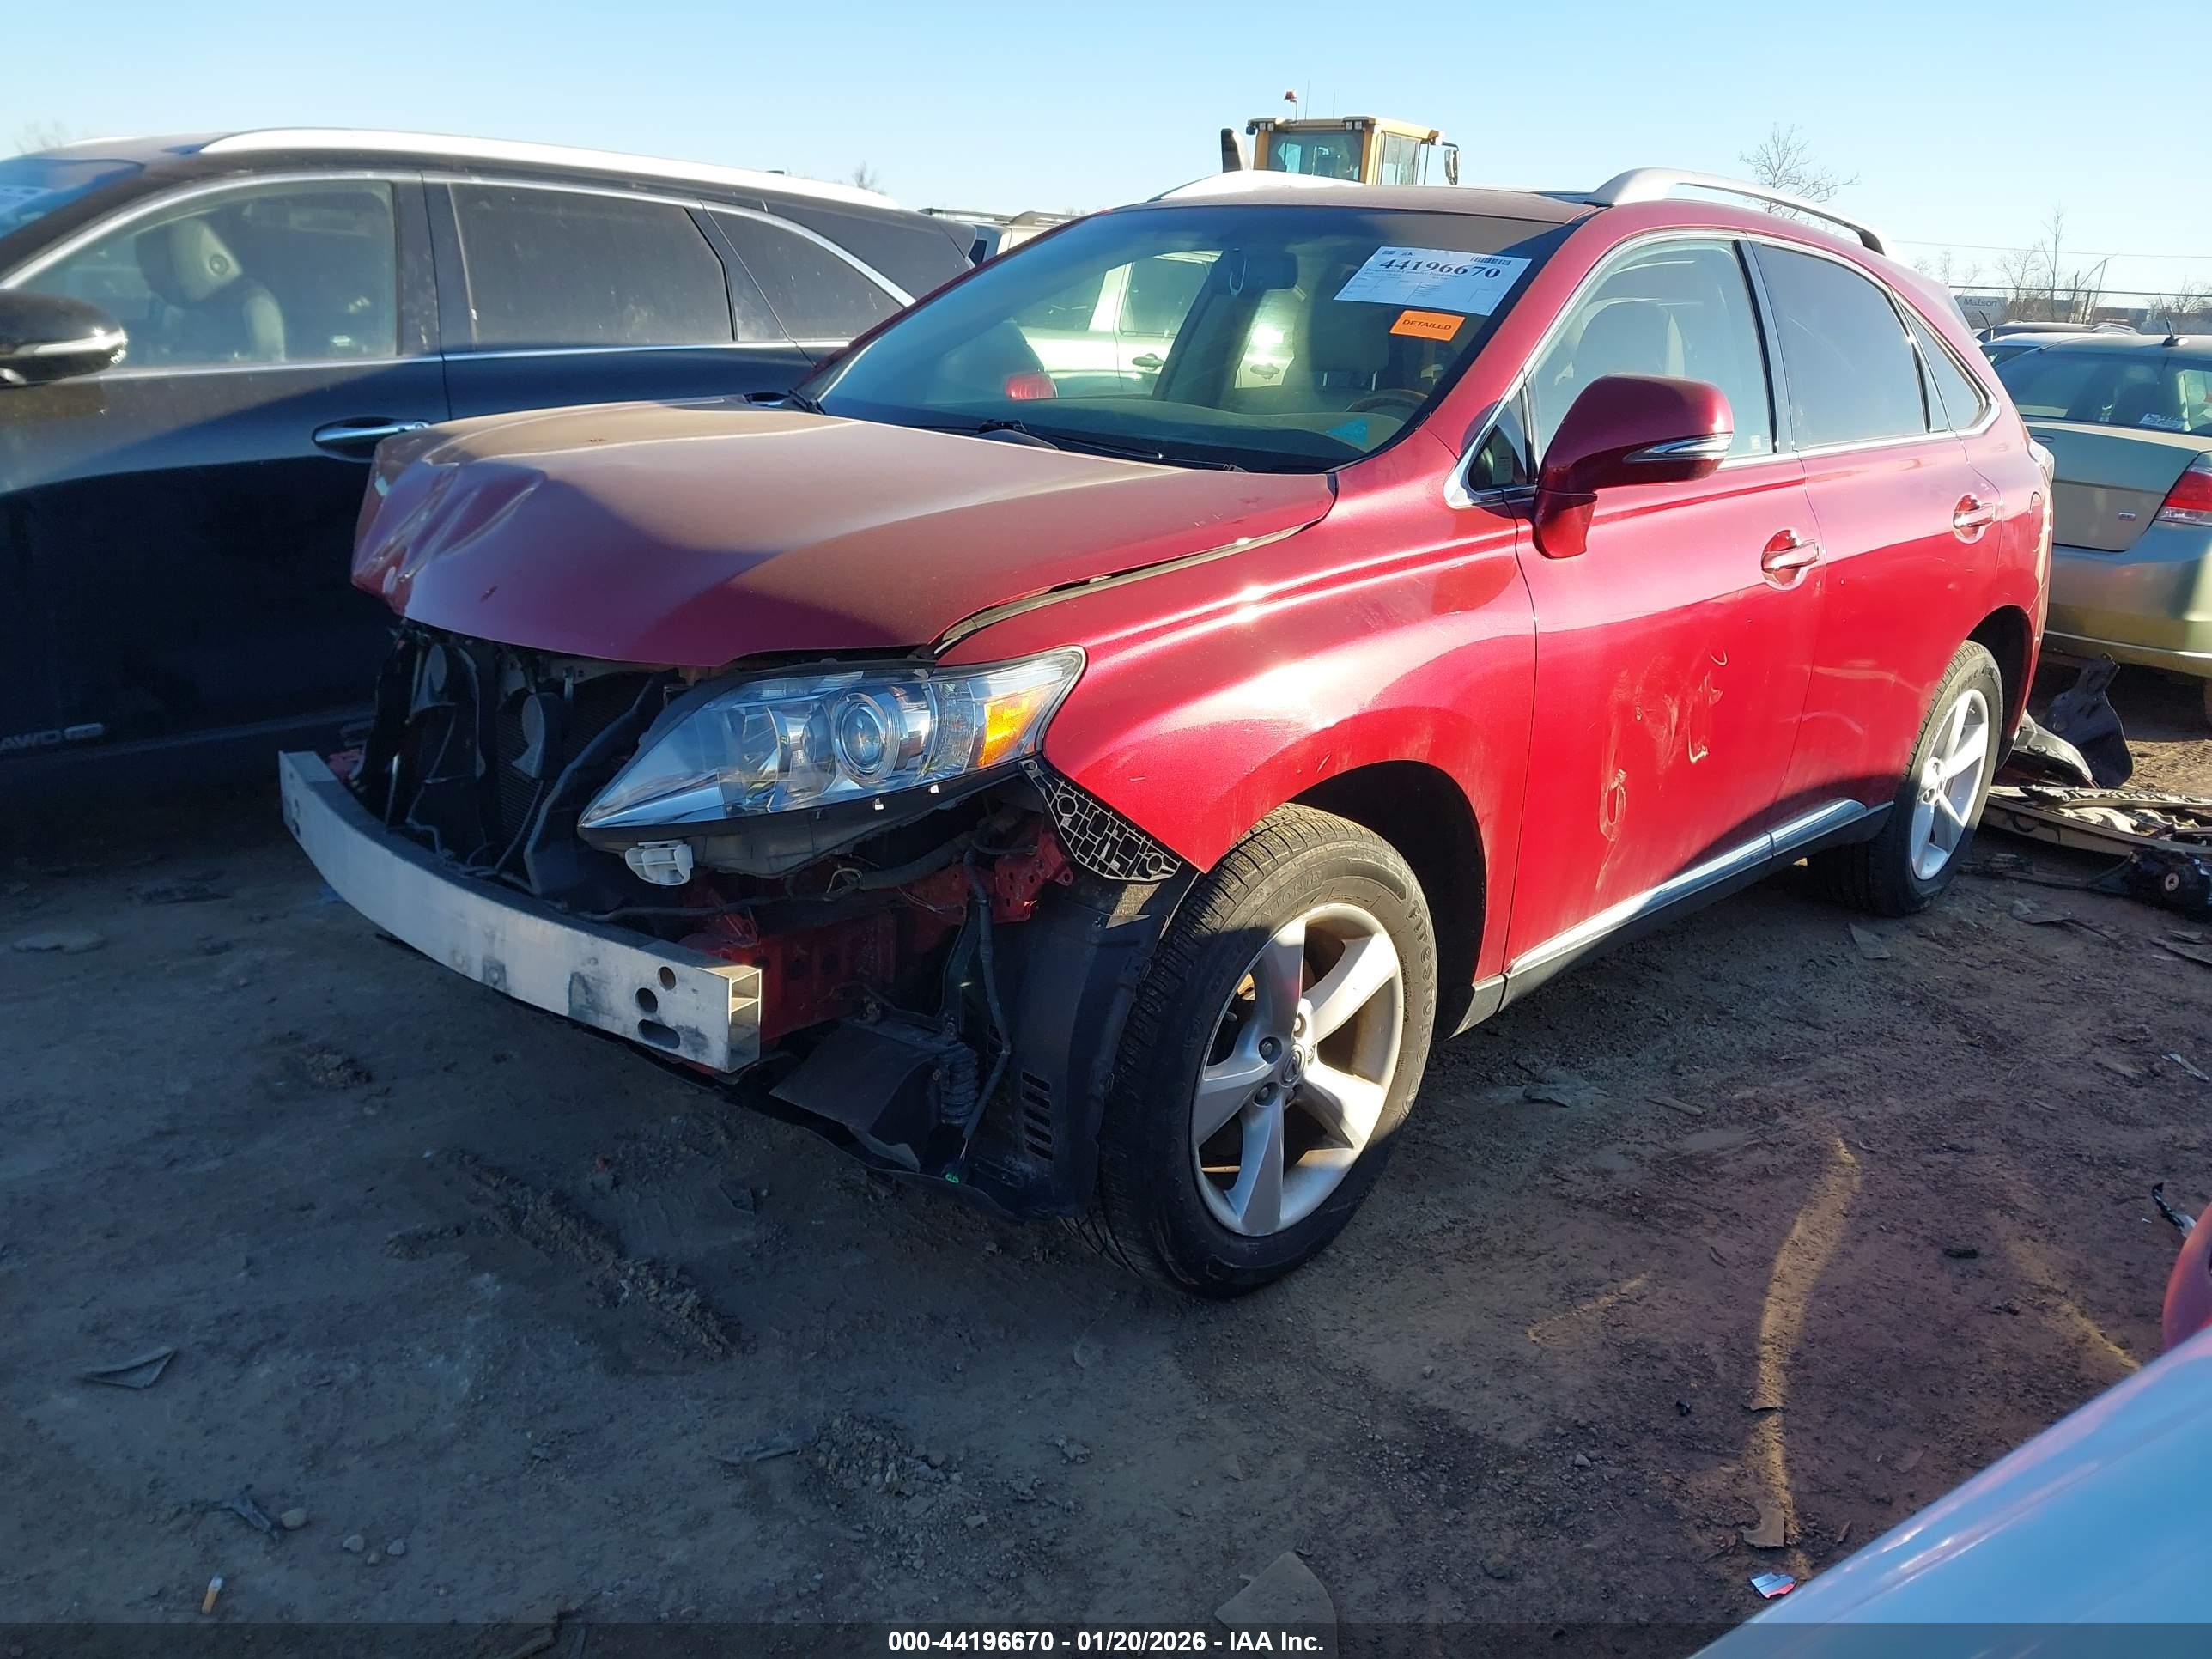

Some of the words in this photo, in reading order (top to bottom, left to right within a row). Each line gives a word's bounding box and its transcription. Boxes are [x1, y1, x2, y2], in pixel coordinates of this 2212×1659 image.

[1379, 258, 1501, 278] 44196670
[1964, 298, 1998, 307] Matson
[1402, 319, 1452, 331] DETAILED
